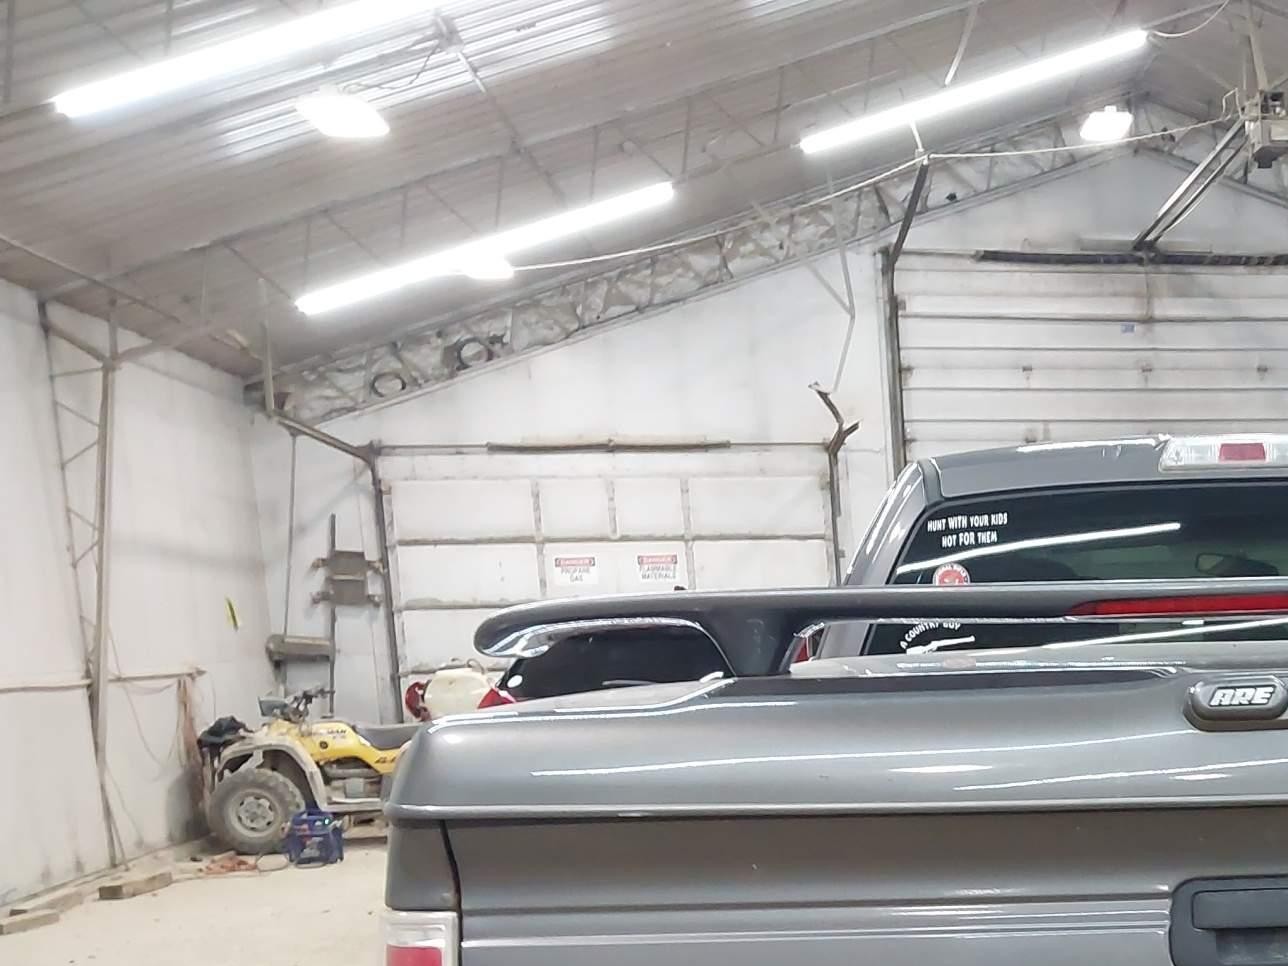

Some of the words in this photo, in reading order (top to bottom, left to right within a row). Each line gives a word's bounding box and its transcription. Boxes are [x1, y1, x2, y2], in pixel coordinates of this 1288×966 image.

[927, 518, 946, 532] HUNT
[948, 515, 968, 529] WITH
[969, 514, 989, 527] YOUR
[991, 512, 1008, 525] KIDS
[942, 534, 957, 547] NOT
[959, 532, 975, 546] FOR
[977, 530, 997, 544] THEM
[1209, 686, 1275, 706] ARE
